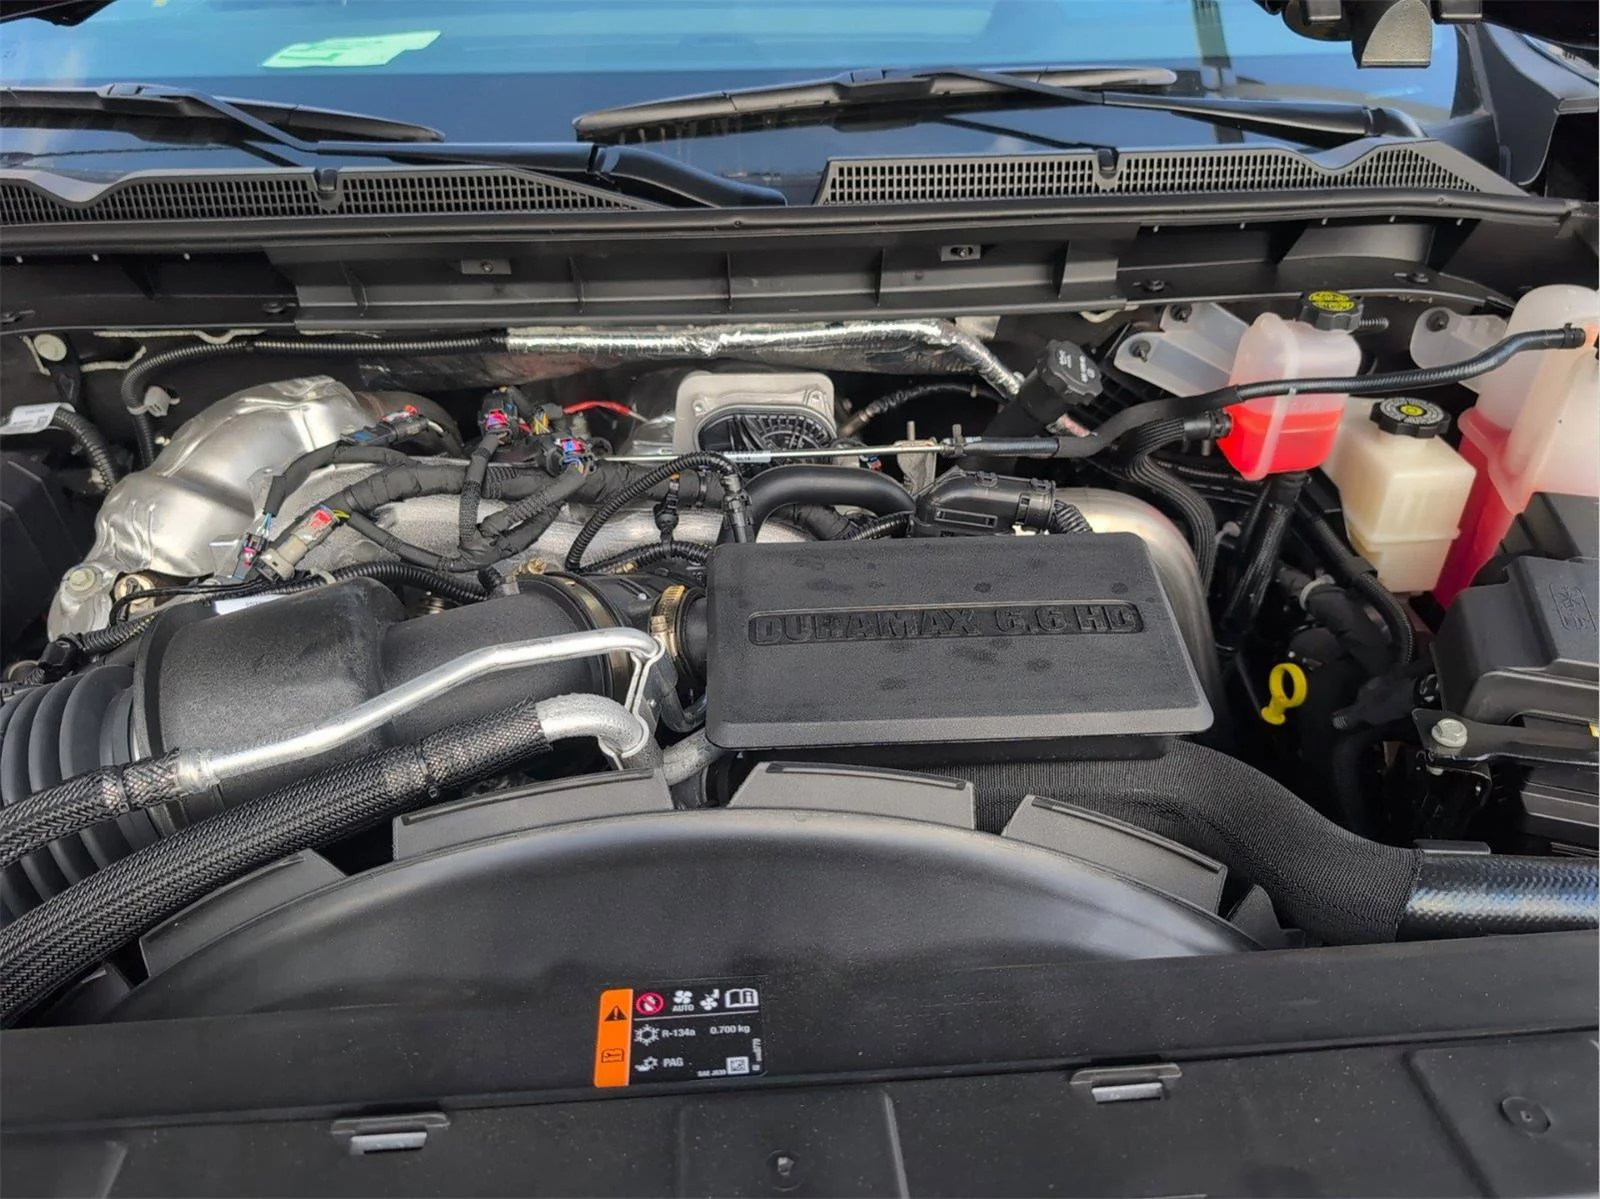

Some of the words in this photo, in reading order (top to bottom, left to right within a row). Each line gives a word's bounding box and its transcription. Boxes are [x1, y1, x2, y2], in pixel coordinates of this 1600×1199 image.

[754, 608, 982, 644] DURAMAX
[994, 605, 1068, 634] 6.6
[672, 1003, 696, 1012] AUTO
[661, 1028, 697, 1038] R-134a
[709, 1025, 737, 1035] 0.700
[737, 1024, 751, 1034] kg
[662, 1057, 685, 1068] PAG
